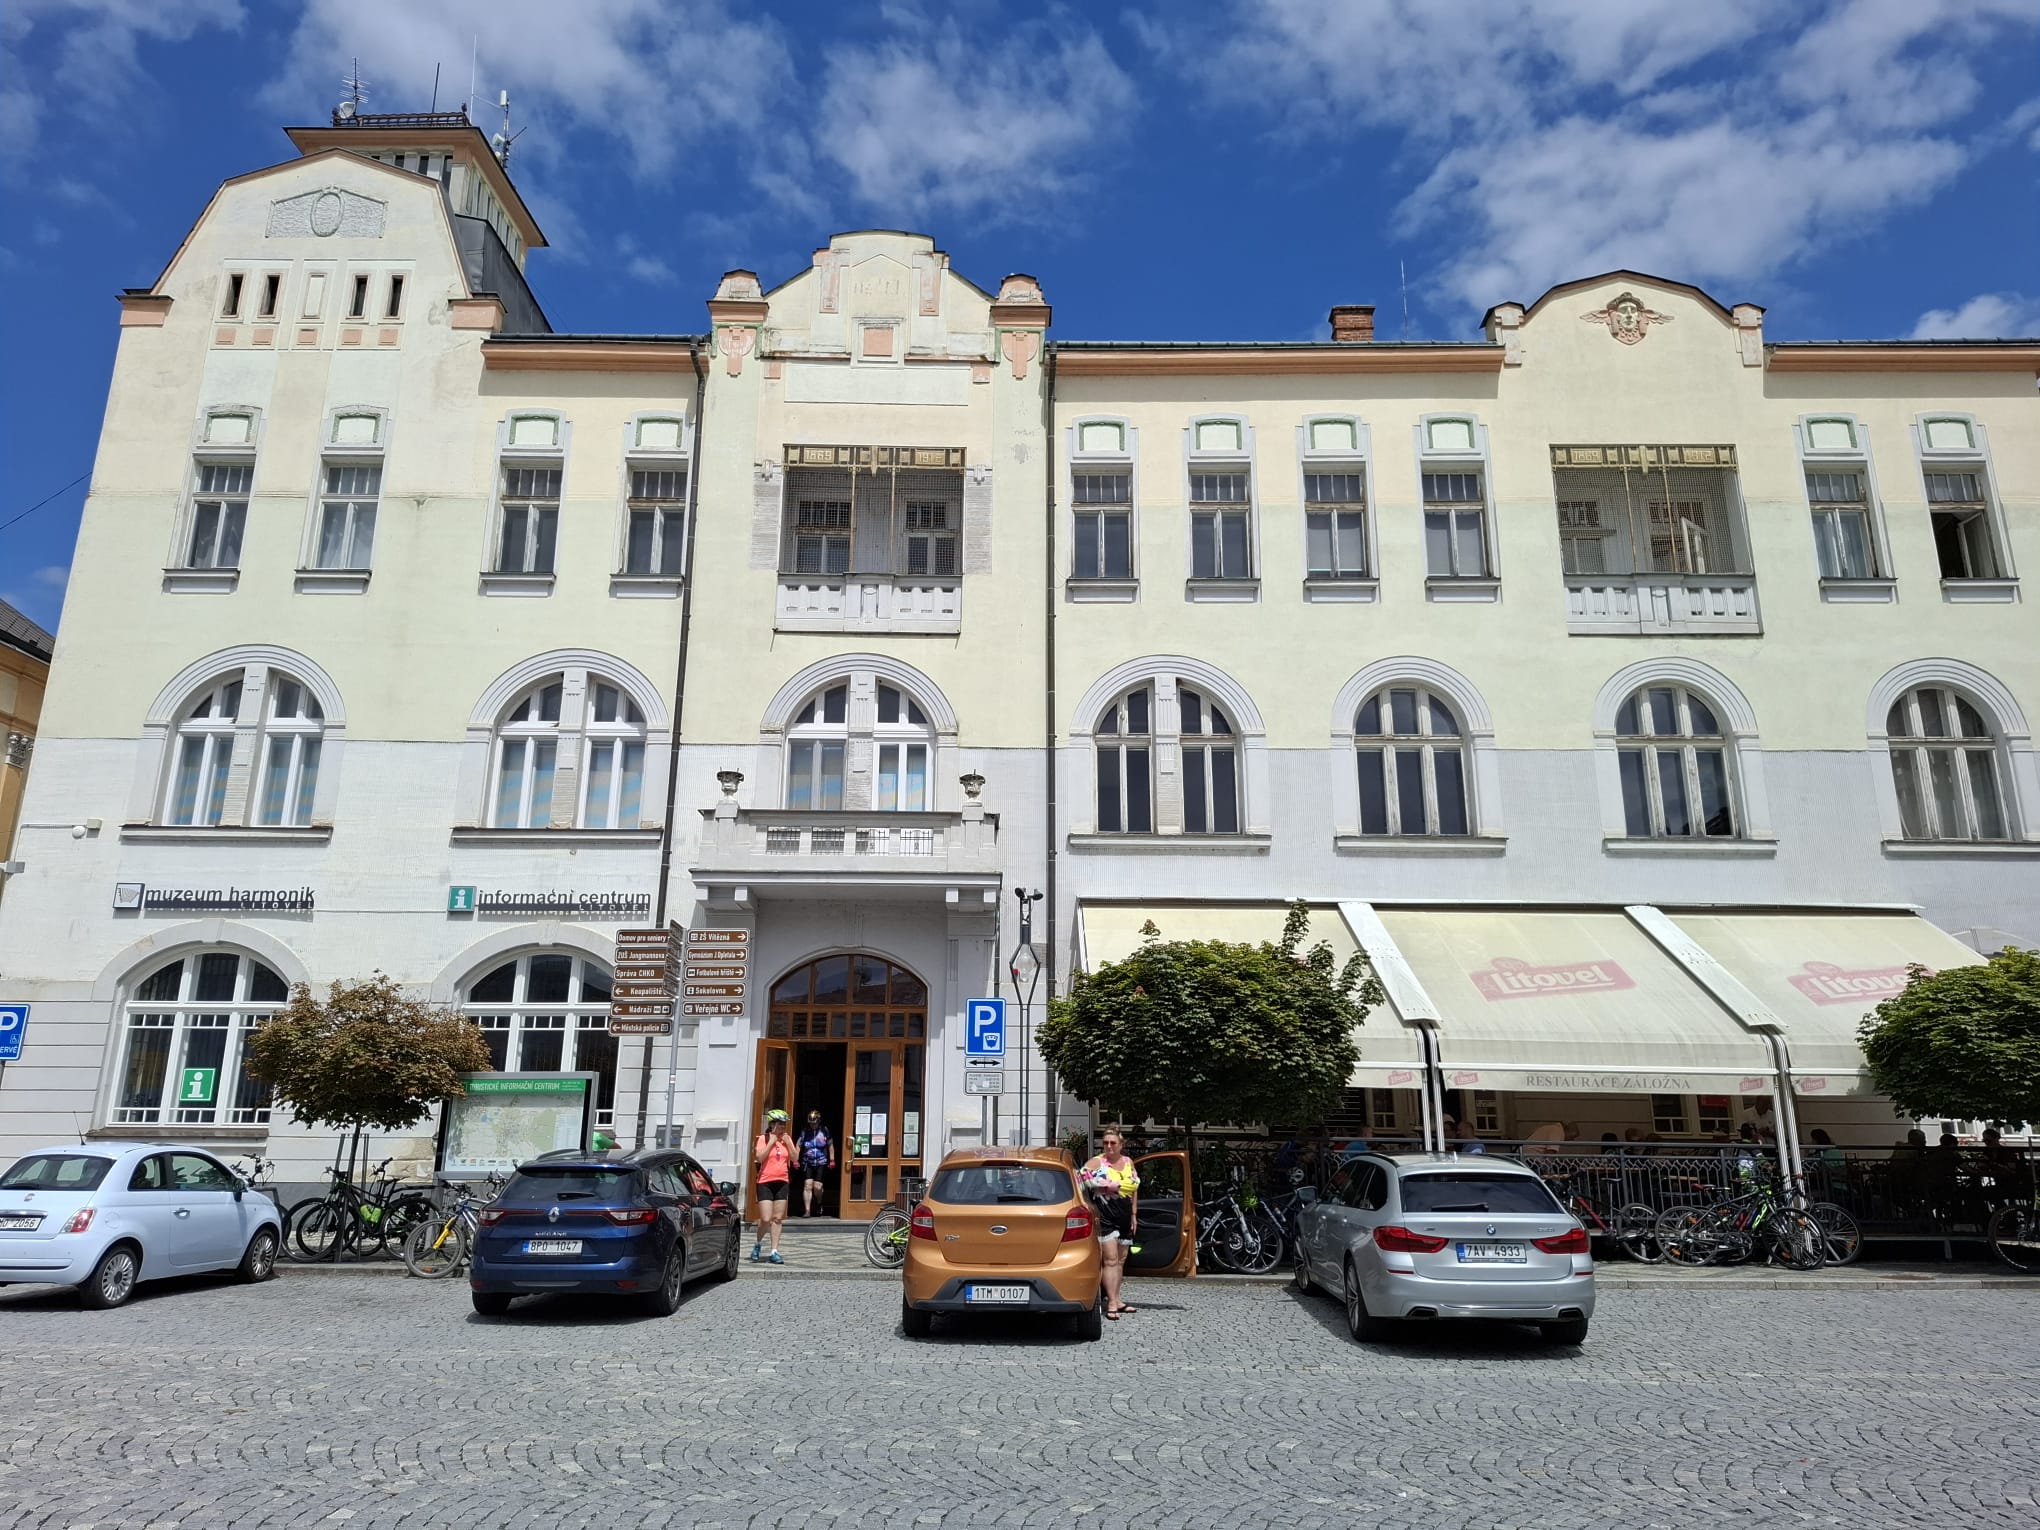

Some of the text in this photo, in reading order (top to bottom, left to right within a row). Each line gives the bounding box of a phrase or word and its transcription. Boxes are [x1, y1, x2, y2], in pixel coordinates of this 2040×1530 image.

[146, 886, 314, 901] muzeum harmonik
[579, 890, 650, 904] centrum
[240, 901, 313, 909] LITOVEL
[616, 969, 637, 978] Správa
[1491, 965, 1615, 995] Litovel
[1806, 974, 1909, 998] Litove
[720, 1004, 731, 1013] WC
[974, 1005, 997, 1037] P
[1526, 1074, 1691, 1089] RESTAURACE ZÁLOŽNA
[555, 1241, 578, 1251] 1047
[1466, 1245, 1521, 1257] 7AV 4933
[975, 1287, 1025, 1299] 1TM 0107
